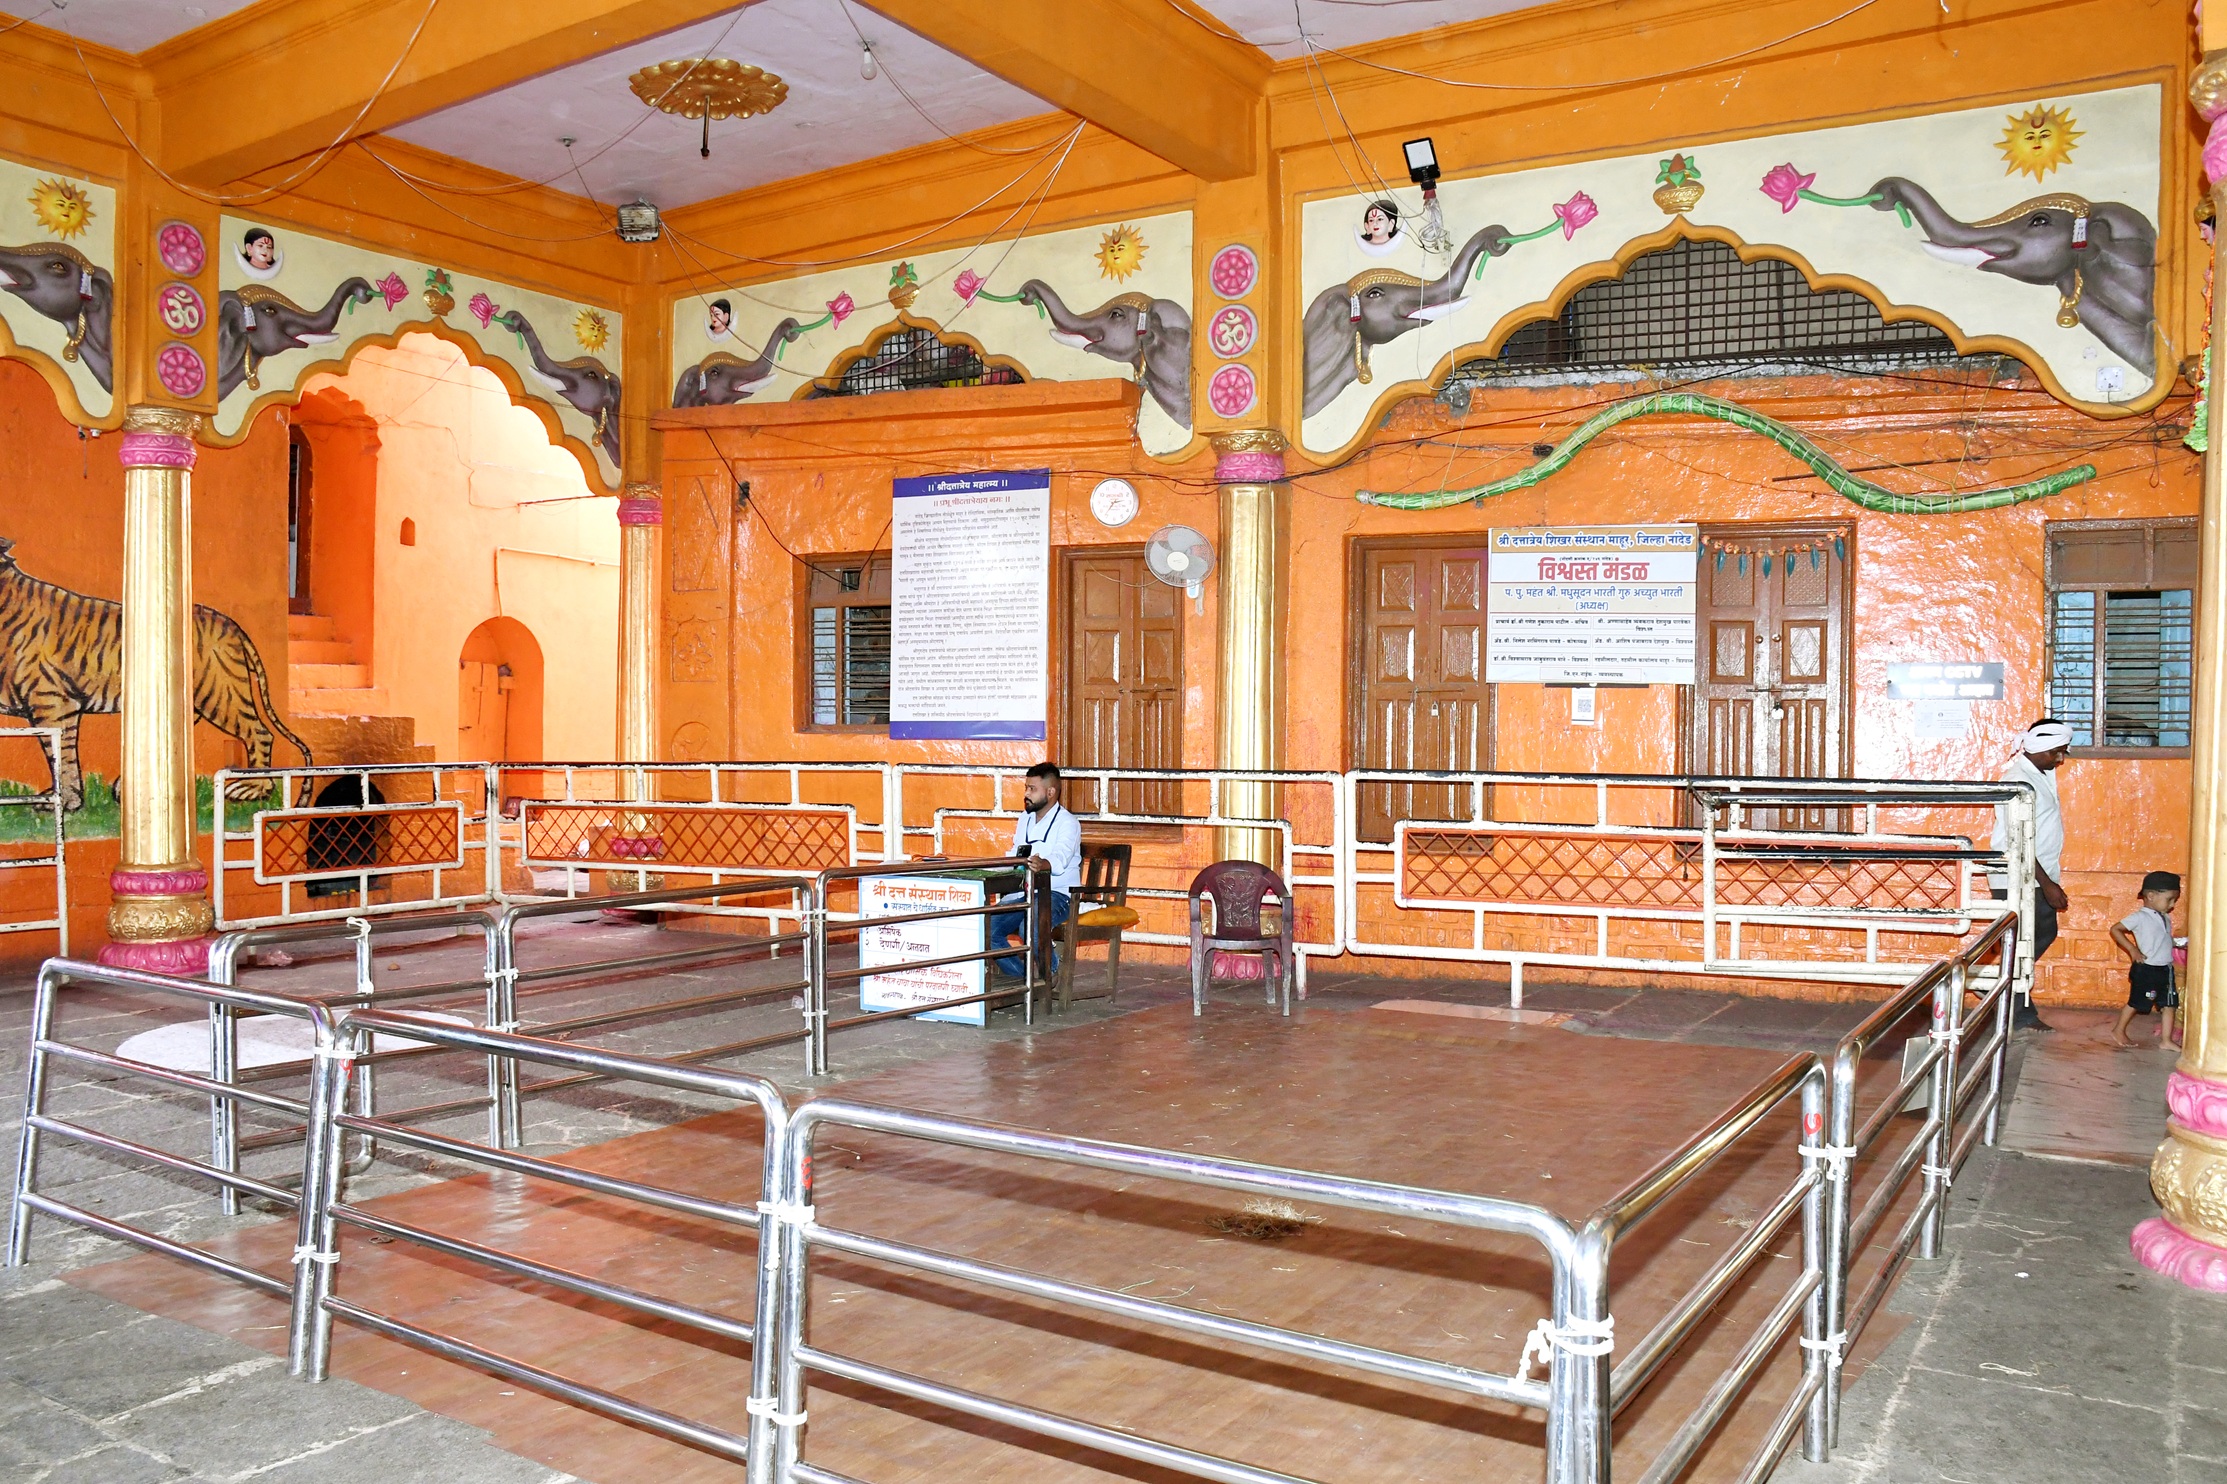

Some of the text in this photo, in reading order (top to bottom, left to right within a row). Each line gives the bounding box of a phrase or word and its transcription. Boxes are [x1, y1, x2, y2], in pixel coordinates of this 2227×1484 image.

[1499, 532, 1692, 548] श्री दत्तात्रेय शिखर संस्थान माहूर, जिल्हा नांदेड
[1538, 557, 1650, 580] विश्वस्त मंडळ
[1505, 588, 1513, 597] प.
[1526, 586, 1543, 597] महंत
[1546, 586, 1558, 597] श्री.
[1561, 588, 1592, 599] मधुसूदन
[1594, 586, 1616, 597] भारती
[1618, 588, 1631, 600] गुरु
[1634, 588, 1658, 600] अच्युत
[1660, 586, 1683, 597] भारती
[1576, 602, 1608, 611] (अध्यक्ष)
[873, 880, 972, 904] श्री दत्त संस्थान शिखर
